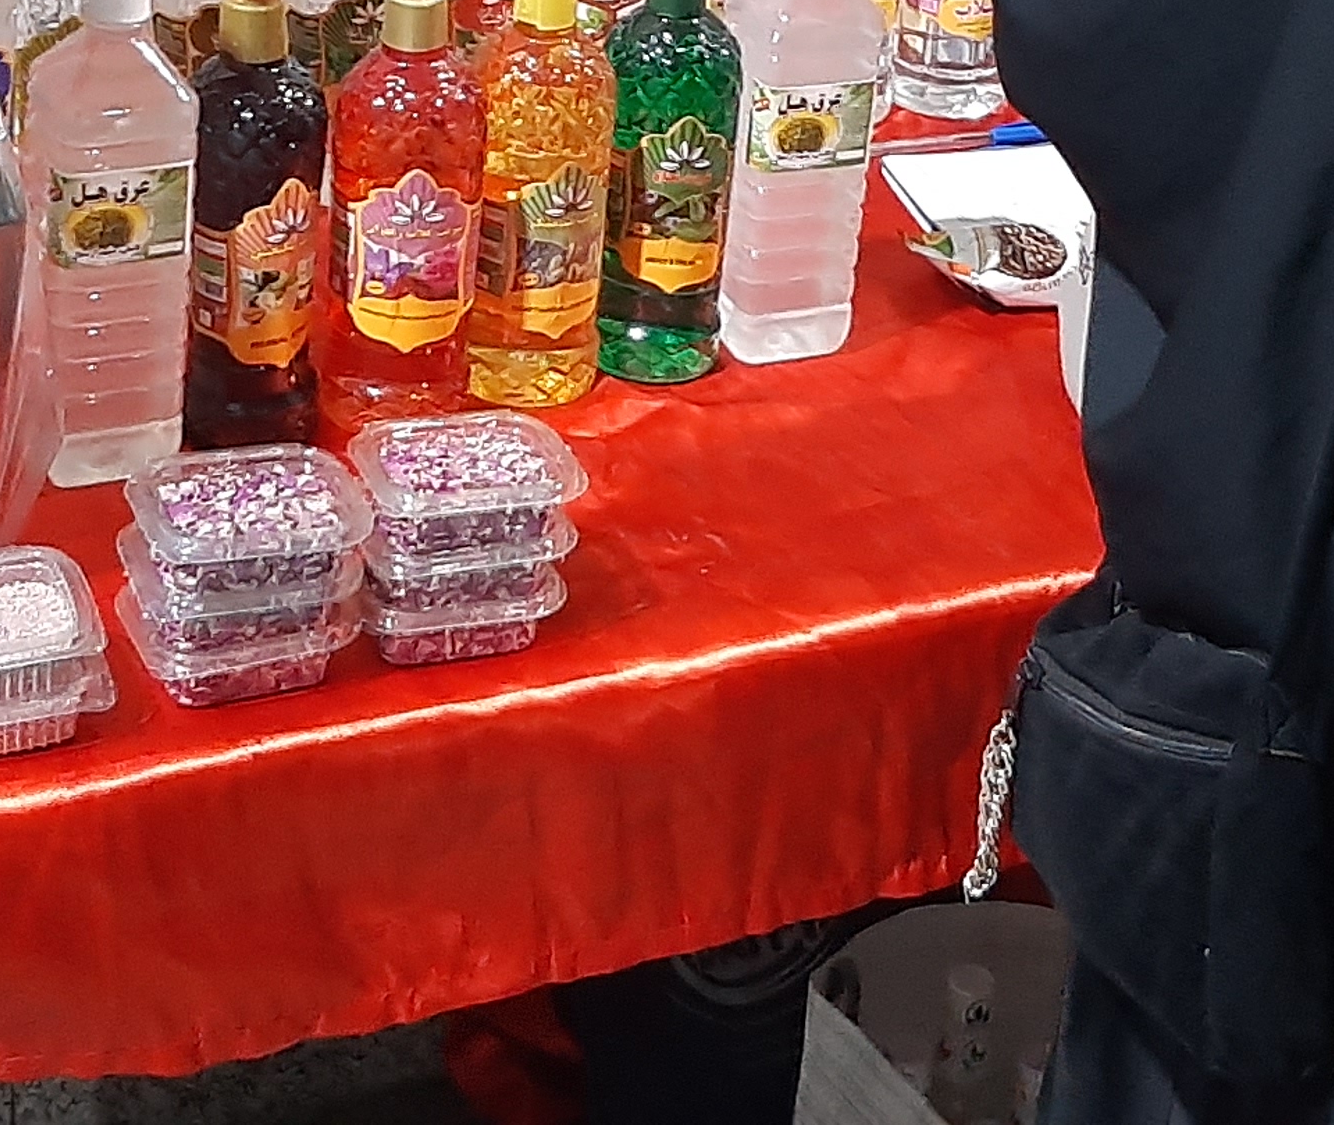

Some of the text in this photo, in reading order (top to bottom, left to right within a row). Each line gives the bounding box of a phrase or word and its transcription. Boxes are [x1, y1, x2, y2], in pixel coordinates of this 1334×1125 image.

[810, 93, 842, 114] عرق
[71, 179, 150, 208] عرق هل
